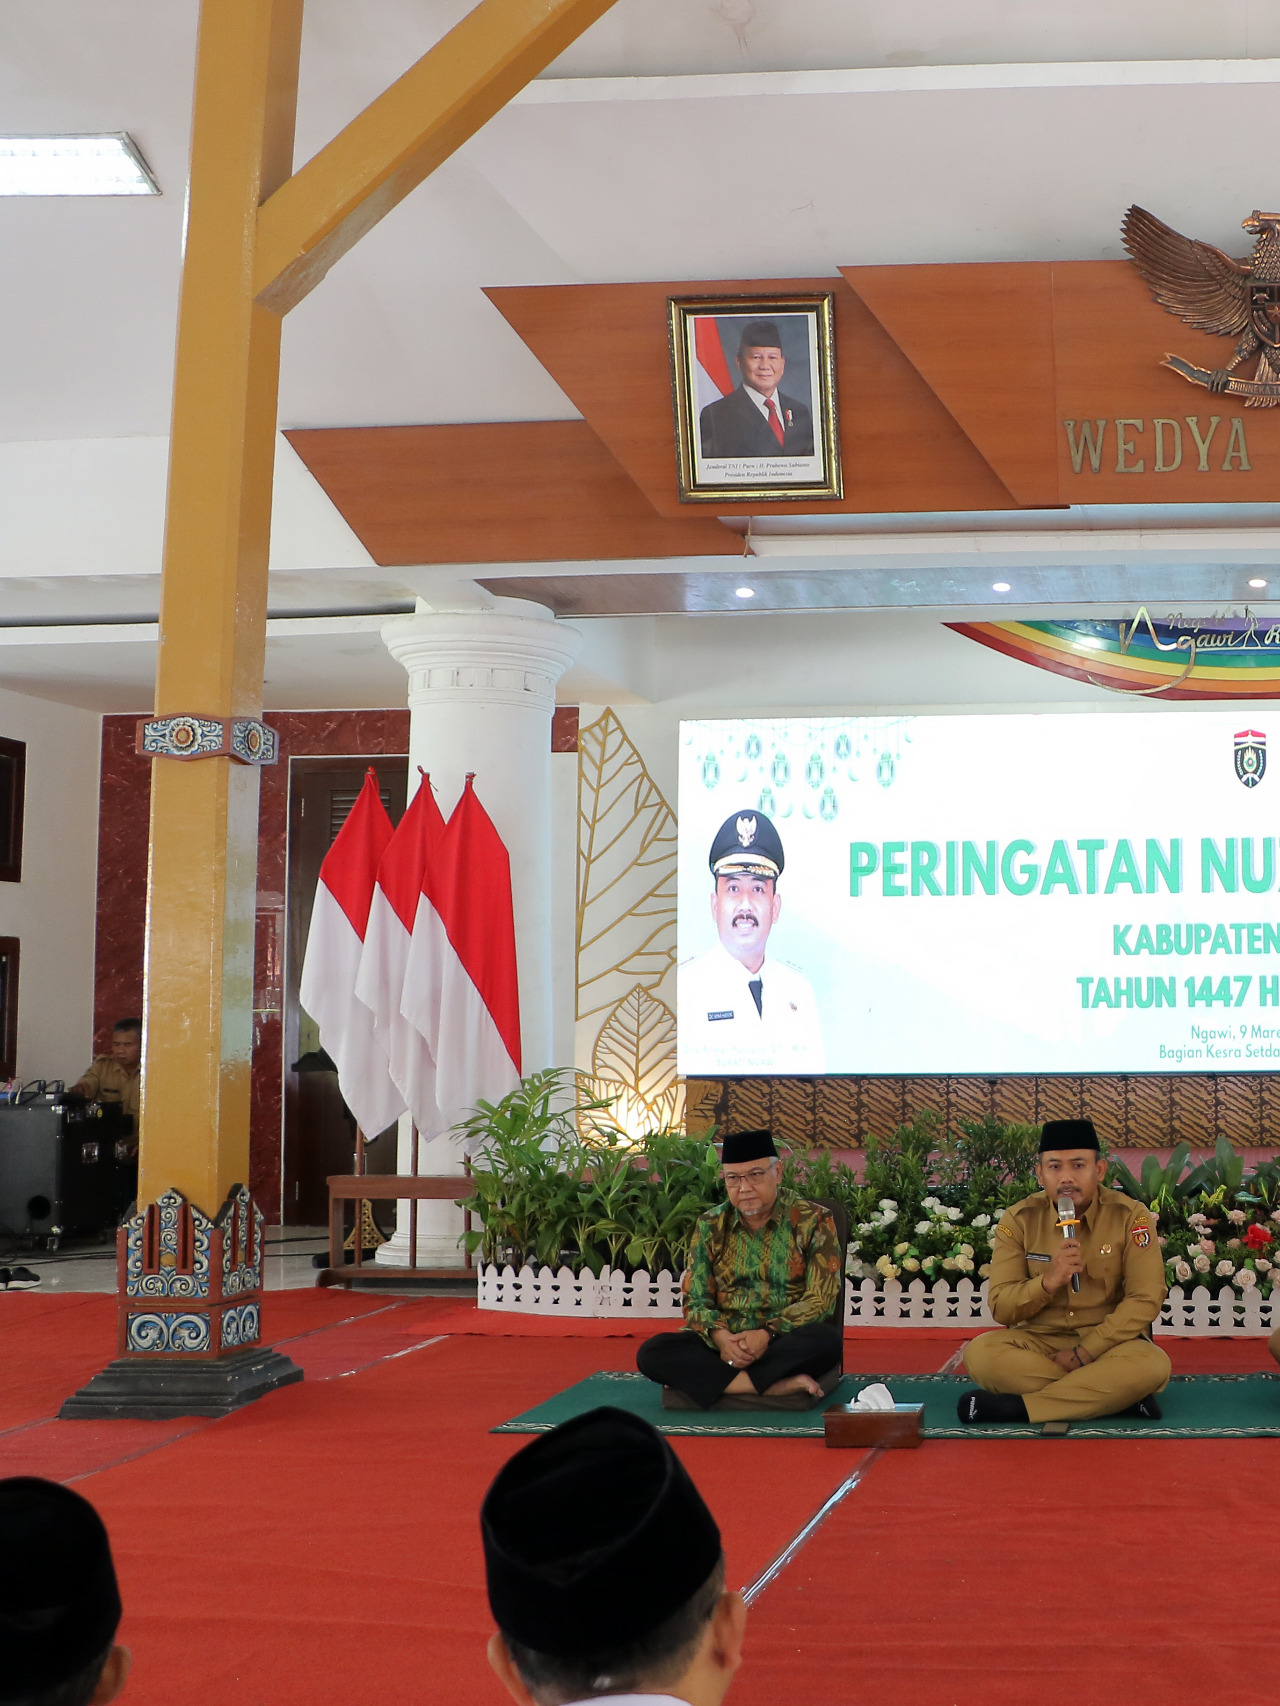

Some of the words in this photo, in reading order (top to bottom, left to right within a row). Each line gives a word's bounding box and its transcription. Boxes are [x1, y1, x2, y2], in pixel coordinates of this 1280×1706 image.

[1228, 381, 1271, 395] BHINNEKA
[1064, 416, 1253, 474] WEDYA
[1166, 610, 1227, 633] Neg
[1087, 605, 1235, 694] Ngawi
[850, 838, 1182, 897] PERINGATAN
[1077, 976, 1176, 1008] TAHUN
[1184, 975, 1252, 1007] 1447
[1259, 975, 1279, 1007] H
[1191, 1025, 1235, 1042] Ngawi,
[1240, 1024, 1247, 1038] 9
[1160, 1044, 1202, 1063] Bagian
[1207, 1044, 1241, 1058] Kesra
[1246, 1043, 1280, 1058] Setda
